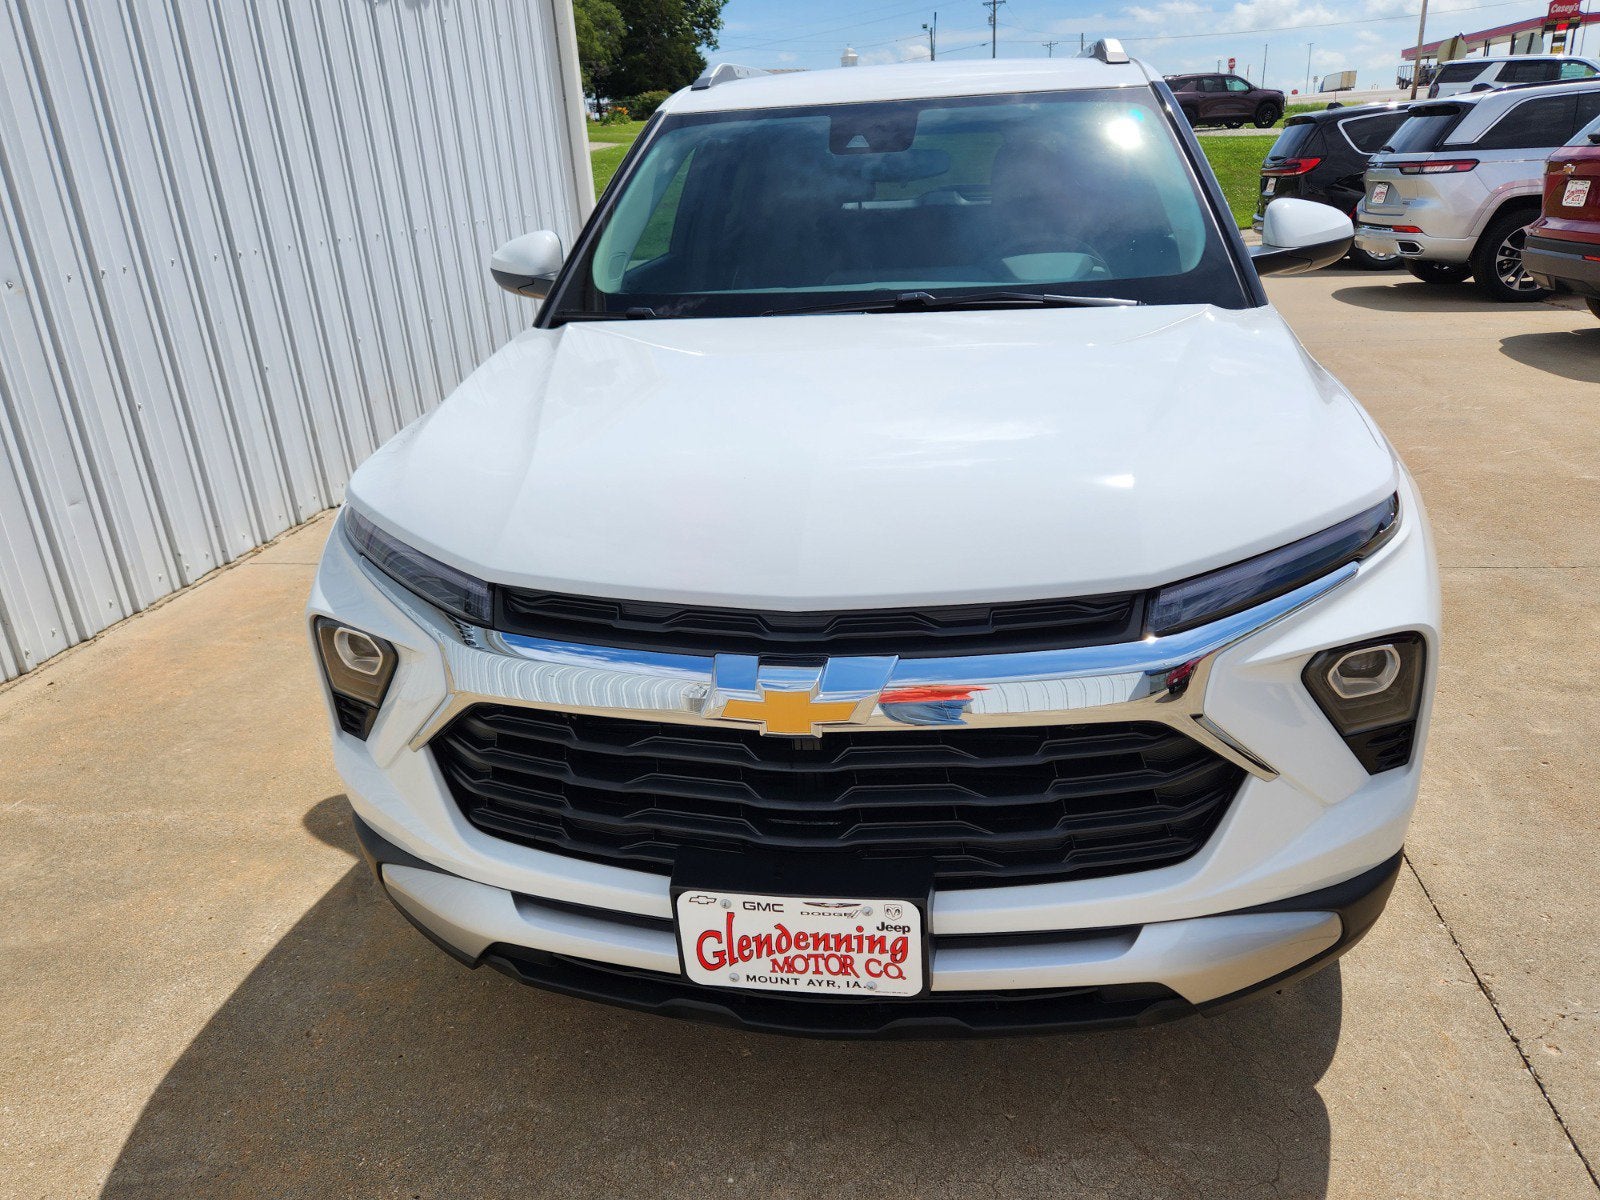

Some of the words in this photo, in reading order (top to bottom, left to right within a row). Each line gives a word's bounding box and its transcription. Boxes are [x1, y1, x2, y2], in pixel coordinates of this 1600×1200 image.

[1550, 2, 1579, 14] Casey's
[742, 901, 784, 913] GMC
[876, 922, 911, 934] Jeep
[696, 912, 909, 971] Glendenning
[770, 953, 860, 978] MOTOR
[746, 974, 800, 986] MOUNT
[807, 979, 841, 989] AYR,
